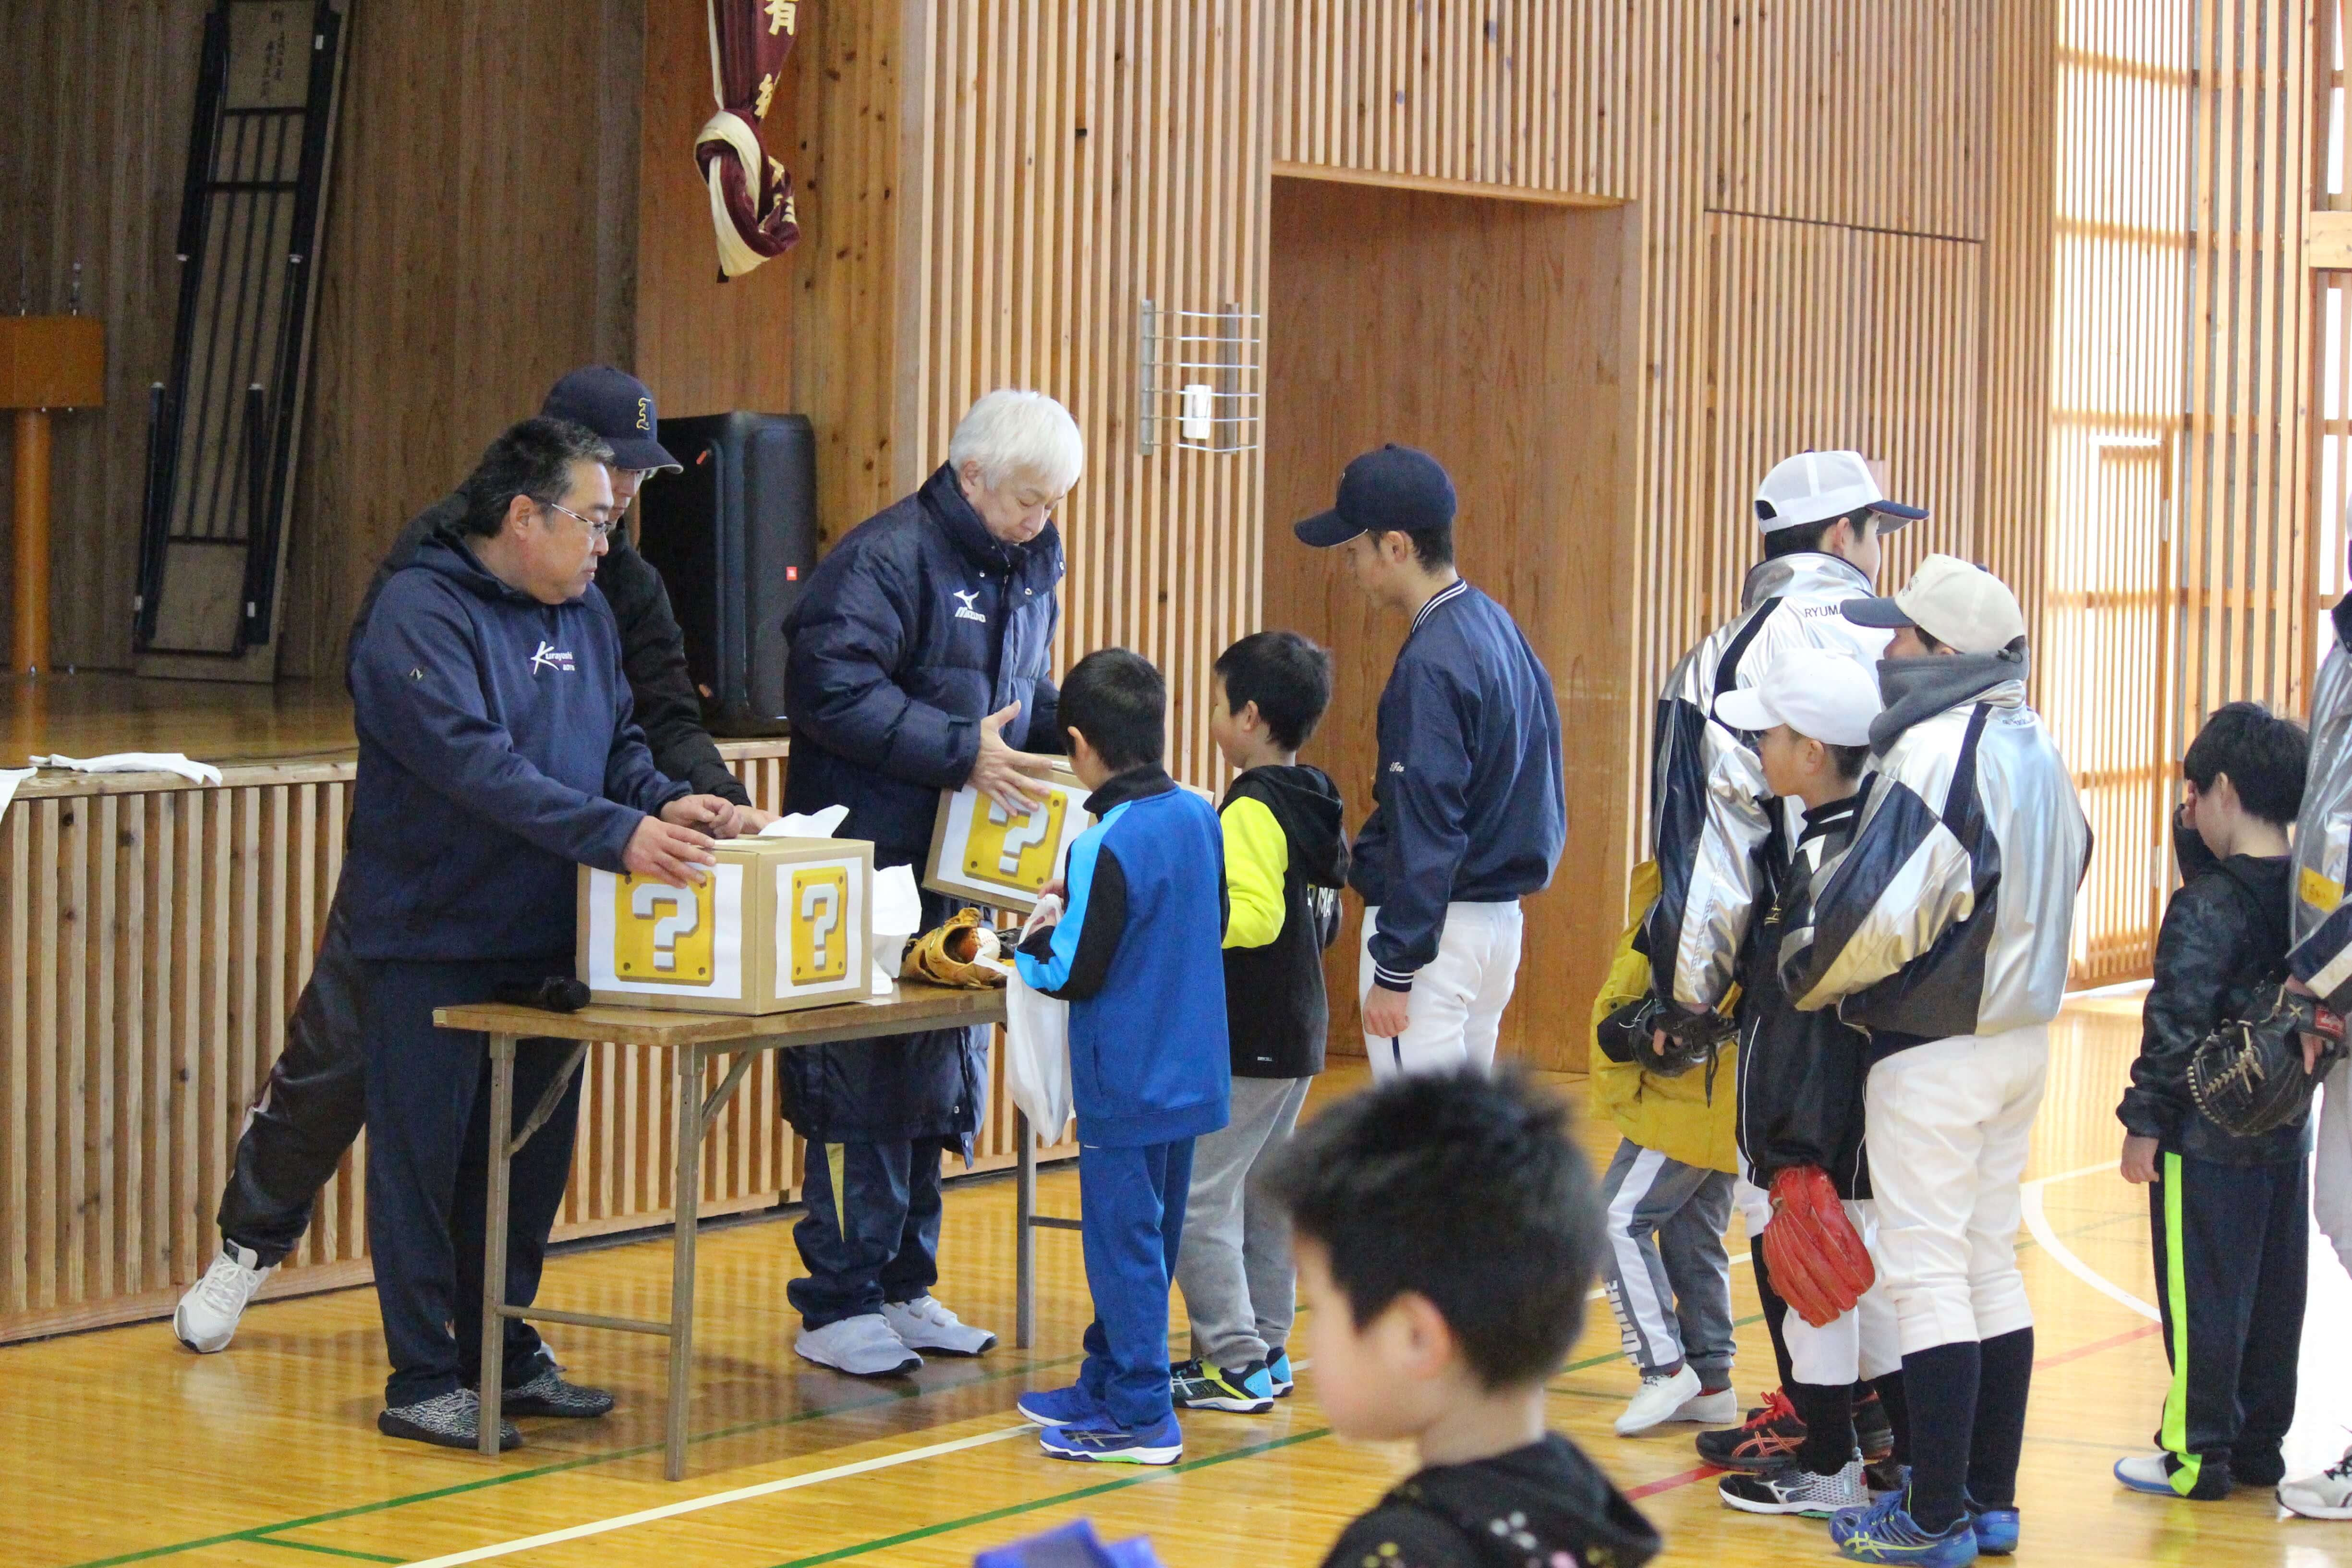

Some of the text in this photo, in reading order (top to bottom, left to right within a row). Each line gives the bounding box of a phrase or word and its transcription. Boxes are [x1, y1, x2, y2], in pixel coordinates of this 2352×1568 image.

[1805, 604, 1841, 618] RYUM
[632, 884, 699, 972] ?
[801, 884, 839, 971] ?
